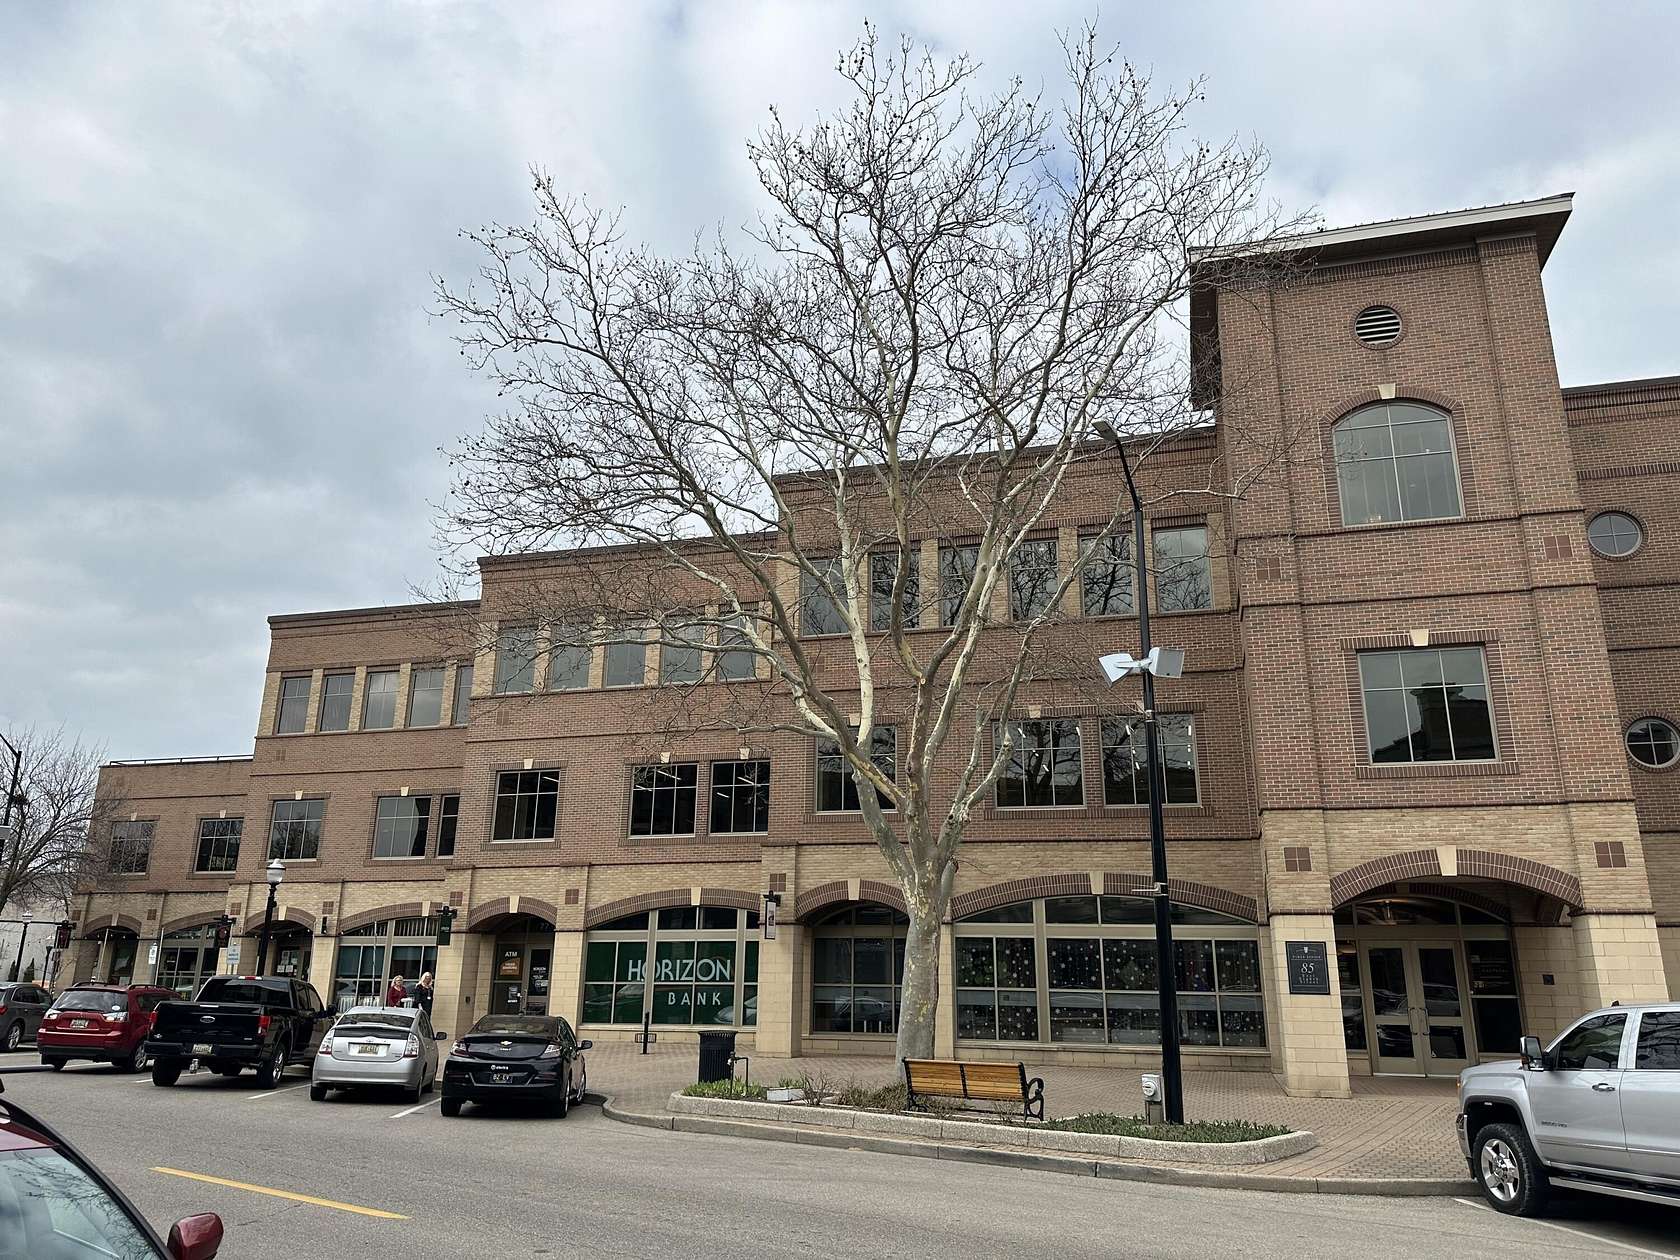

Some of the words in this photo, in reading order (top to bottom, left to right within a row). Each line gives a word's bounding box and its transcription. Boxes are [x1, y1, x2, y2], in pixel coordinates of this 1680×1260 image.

[627, 958, 731, 981] HORIZON
[1301, 962, 1315, 974] 85
[667, 991, 721, 1006] BANK
